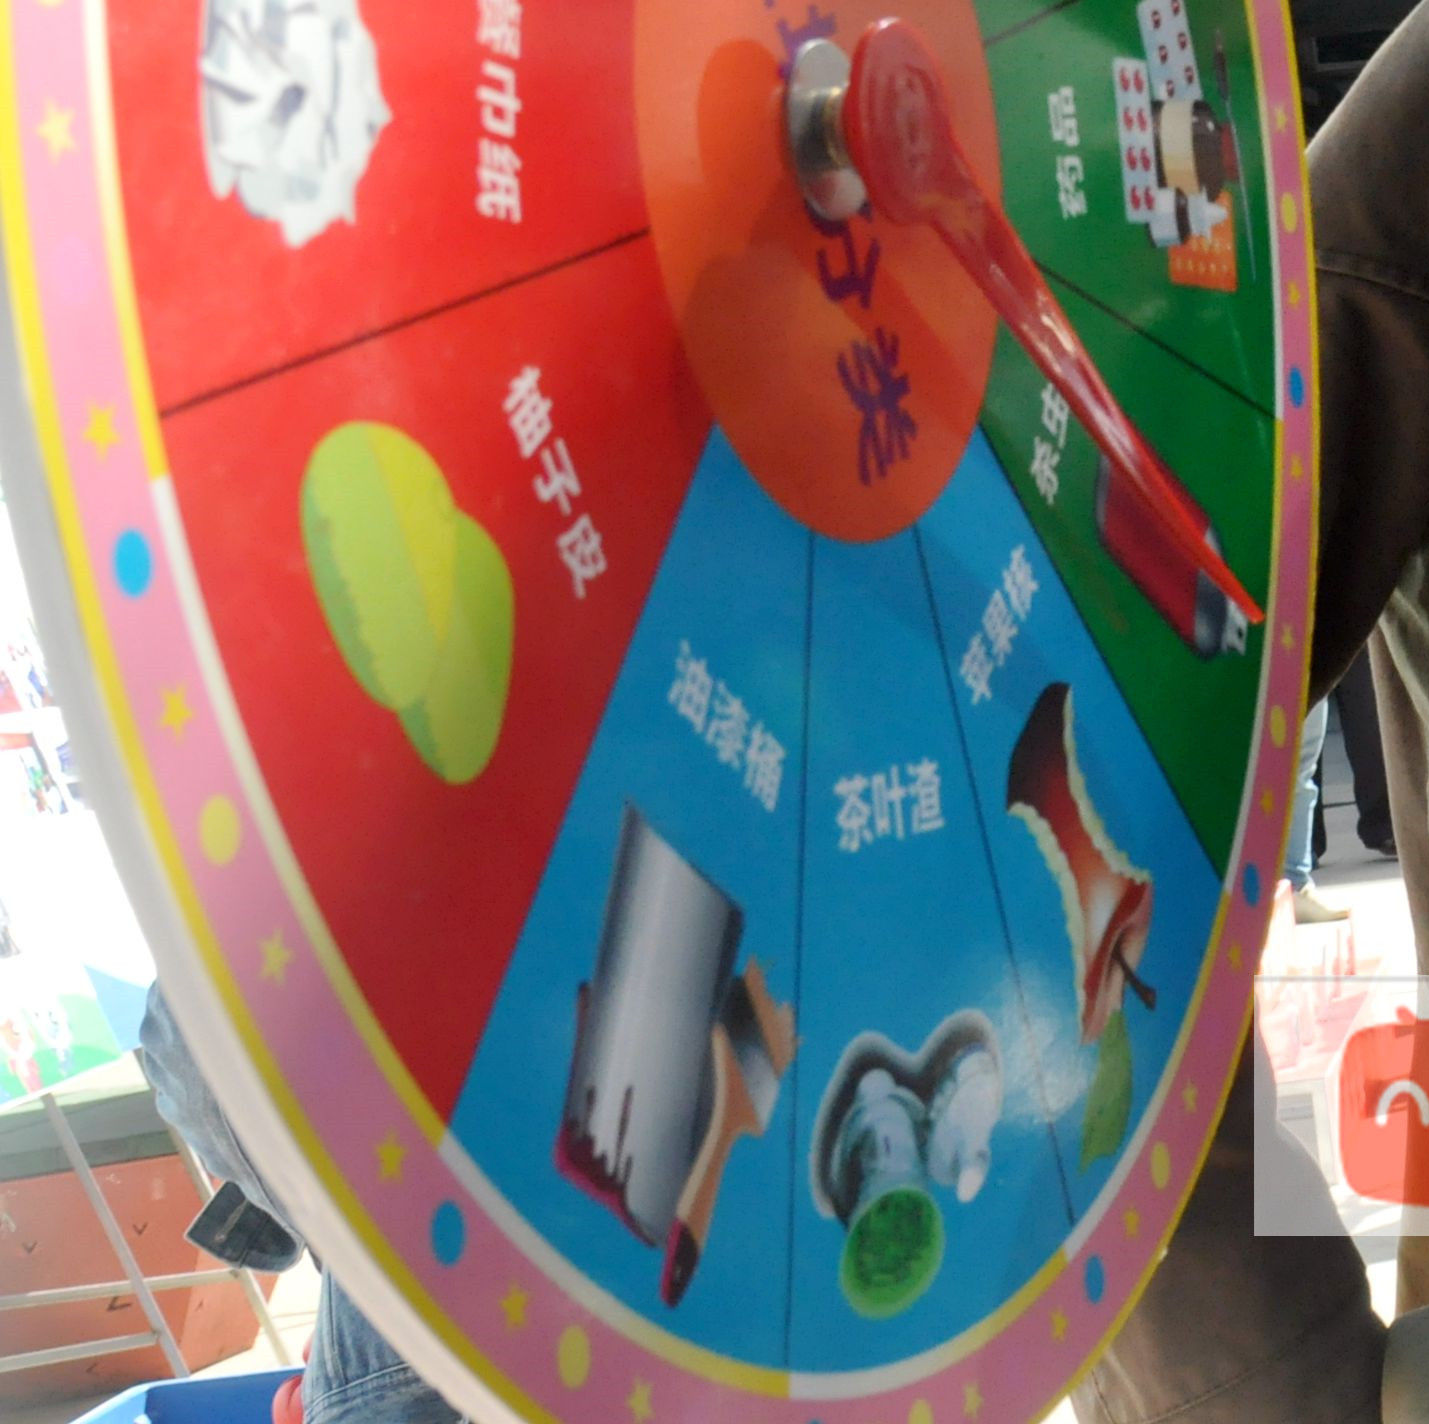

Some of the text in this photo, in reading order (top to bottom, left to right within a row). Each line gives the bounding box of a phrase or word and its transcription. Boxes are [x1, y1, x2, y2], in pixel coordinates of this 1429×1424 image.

[1048, 84, 1086, 222] 药品
[500, 365, 608, 599] 柚子皮
[958, 544, 1041, 706] 苹果核
[666, 640, 789, 813] 油漆桶
[832, 759, 945, 852] 茶叶渣
